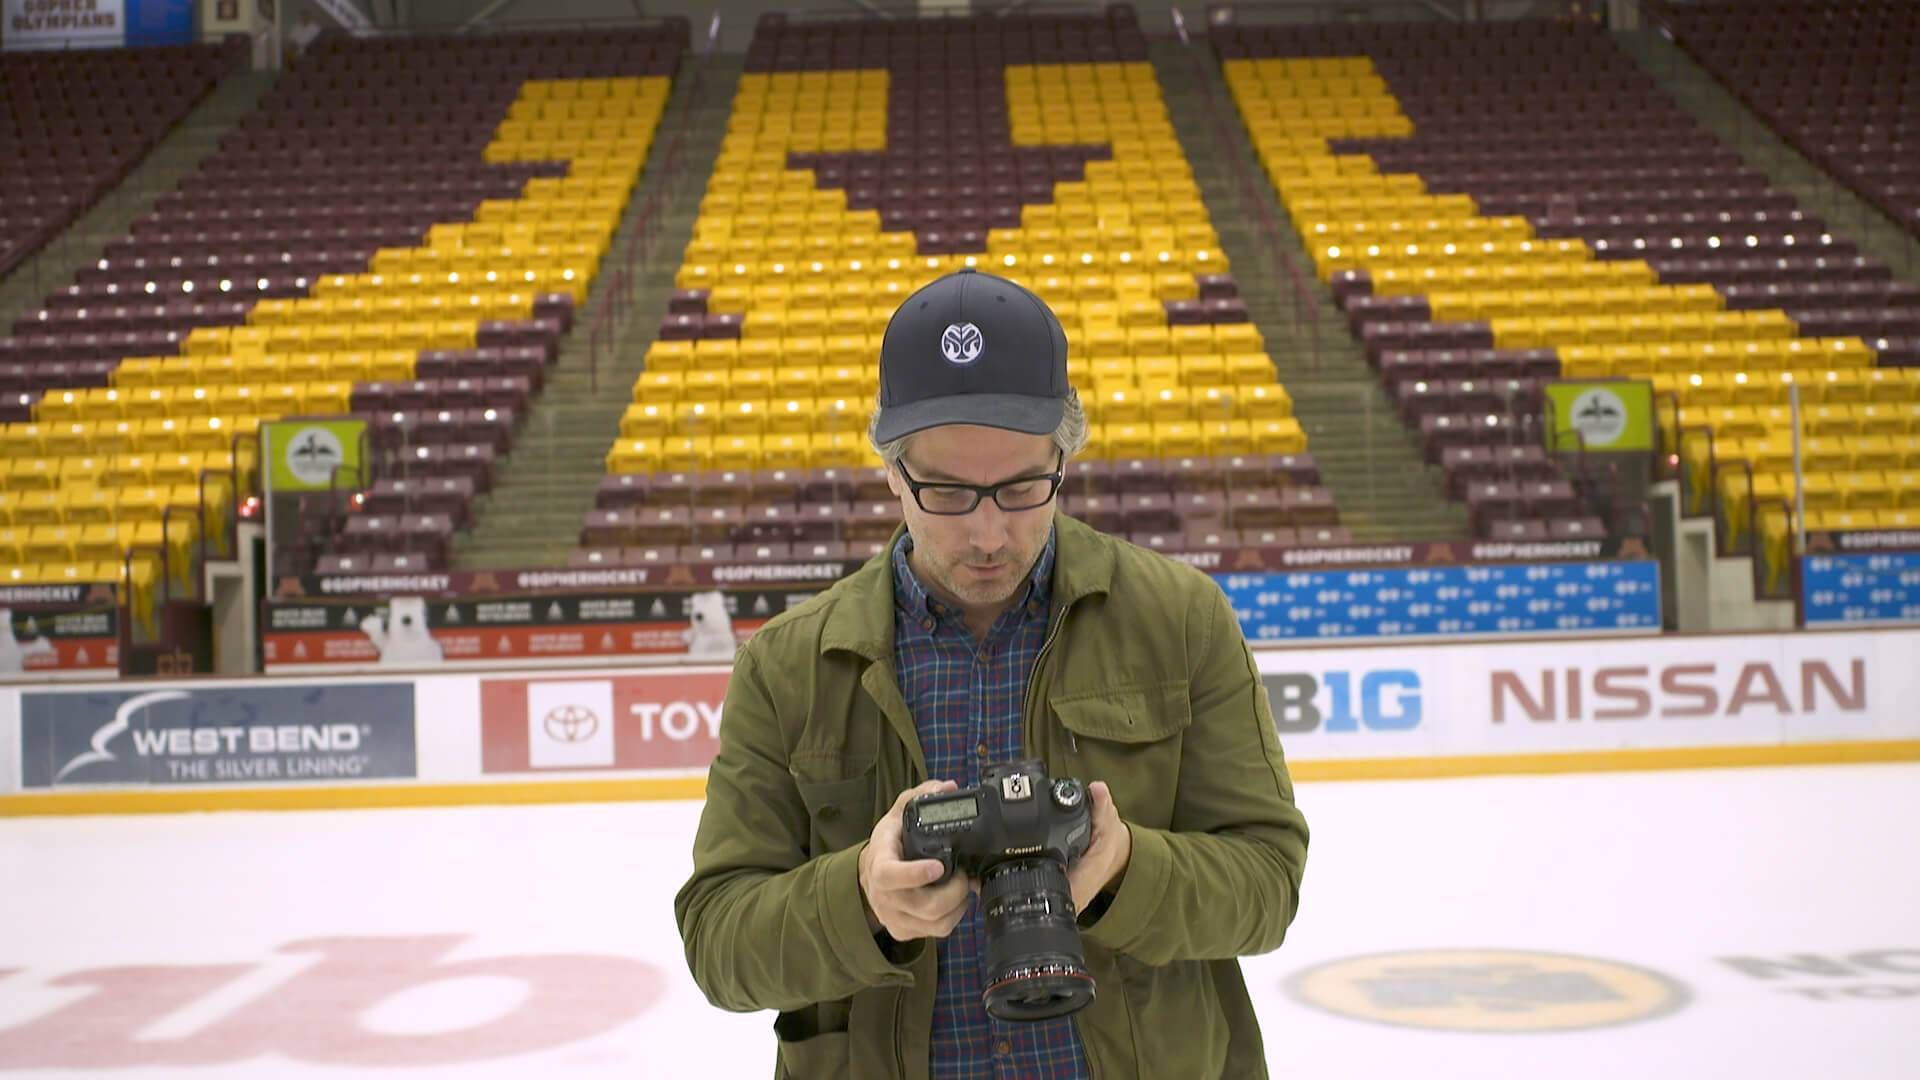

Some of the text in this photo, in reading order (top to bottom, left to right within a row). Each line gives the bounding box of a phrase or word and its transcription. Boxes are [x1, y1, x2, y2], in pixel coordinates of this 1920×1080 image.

[1282, 546, 1413, 566] @GOPHERHOCKEY
[1472, 541, 1602, 559] @GOPHERHOCKEY
[517, 569, 649, 588] @GOPHERHOCKEY
[711, 564, 844, 581] @GOPHERHOCKEY
[320, 575, 450, 593] @GOPHERHOCKEY
[1490, 658, 1868, 724] NISSAN
[630, 701, 724, 741] TOY
[132, 726, 244, 756] WEST
[168, 760, 210, 779] THE
[216, 757, 281, 778] SILVER
[1004, 844, 1042, 855] Canon
